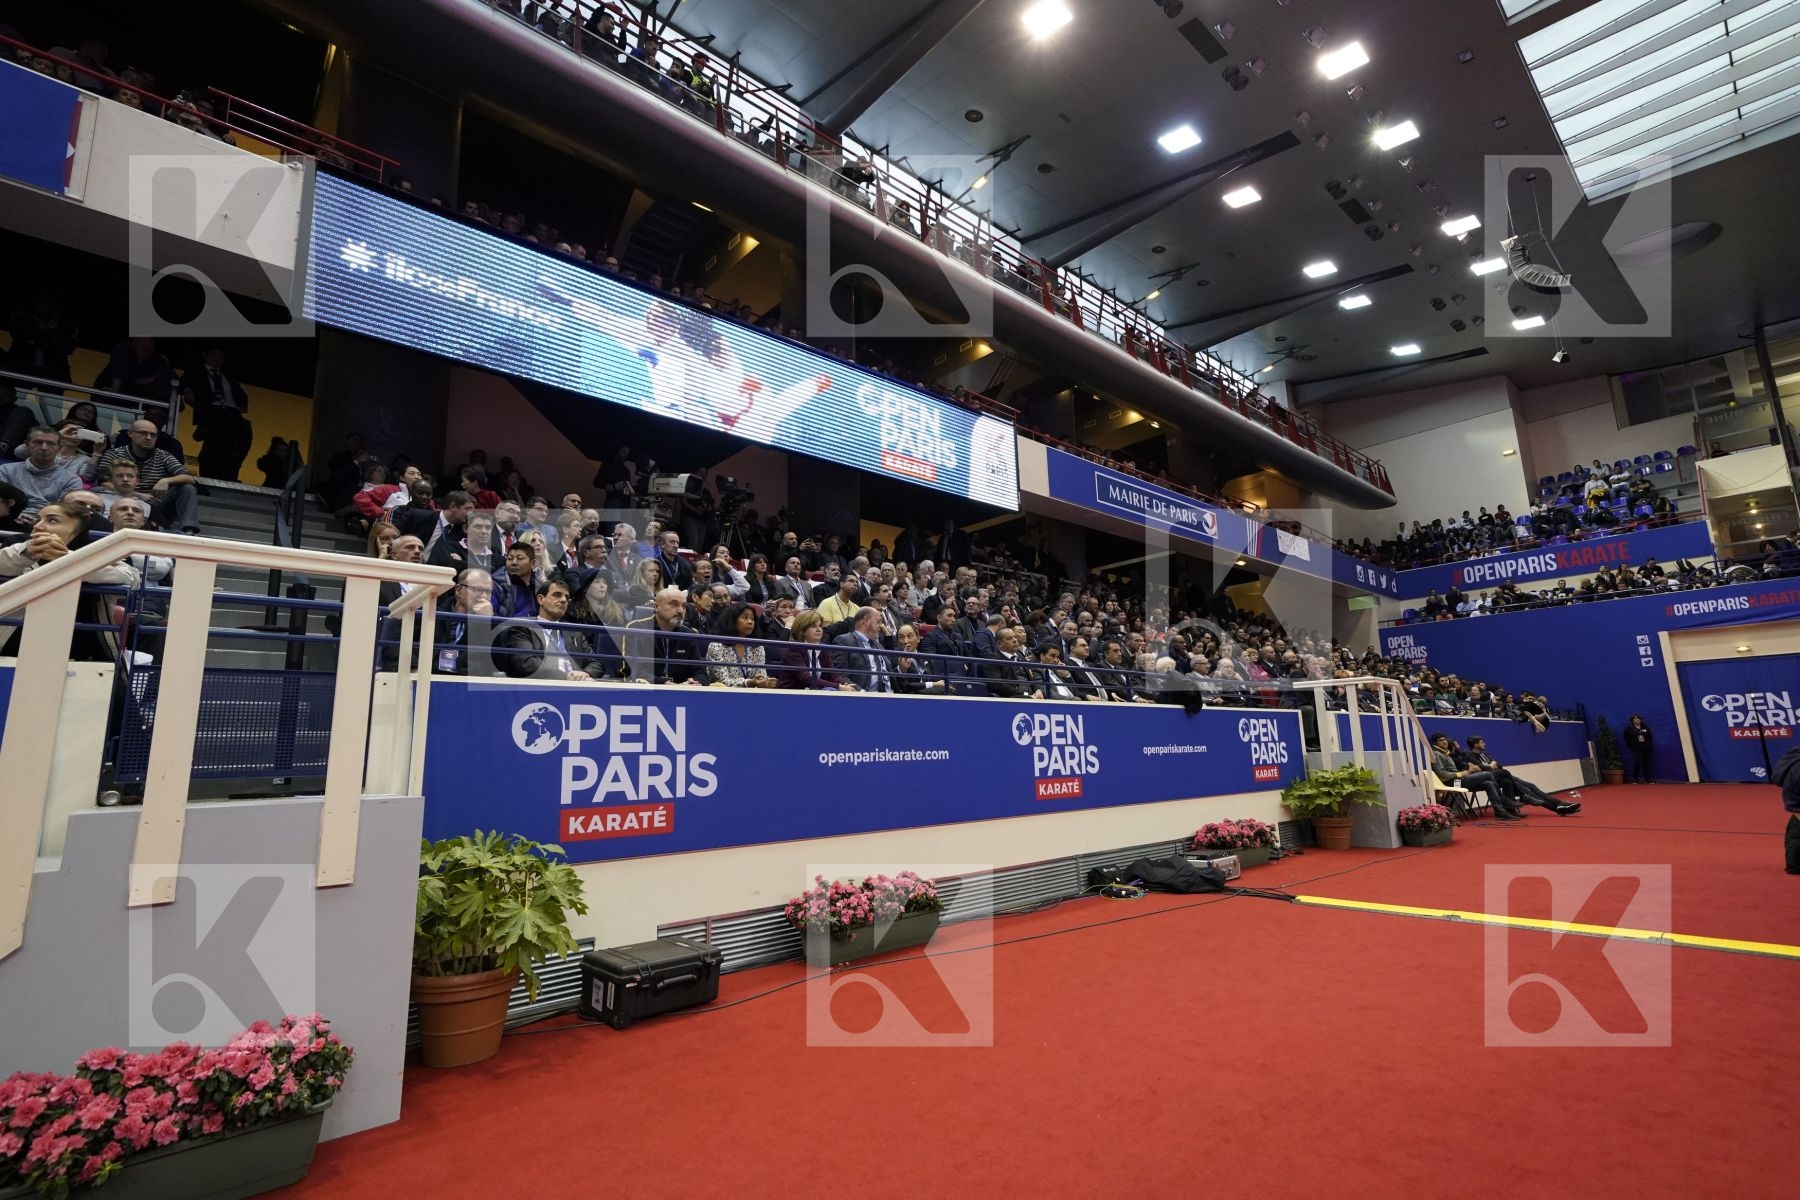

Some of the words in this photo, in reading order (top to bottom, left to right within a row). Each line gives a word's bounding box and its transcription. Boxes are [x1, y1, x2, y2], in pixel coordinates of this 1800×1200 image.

[856, 383, 941, 434] OPEN
[881, 421, 957, 469] PARIS
[1109, 484, 1150, 510] MAIRIE
[1153, 498, 1167, 516] DE
[1169, 504, 1197, 525] PARIS
[1454, 541, 1631, 584] #OPENPARISKARATE
[1388, 635, 1414, 649] OPEN
[1398, 646, 1427, 659] PARIS
[1702, 691, 1792, 711] OPEN
[512, 702, 687, 755] OPEN
[1012, 713, 1084, 746] OPEN
[1238, 717, 1279, 742] OPEN
[1734, 727, 1788, 737] KARATÉ
[819, 748, 950, 766] openpariskarate.com
[1033, 745, 1100, 777] PARIS
[1143, 744, 1207, 756] openpariskarate.com
[1251, 741, 1288, 765] PARIS
[560, 752, 718, 805] PARIS
[1255, 766, 1279, 779] KARATÉ
[1039, 779, 1080, 796] KARATÉ
[568, 806, 667, 835] KARATÉ
